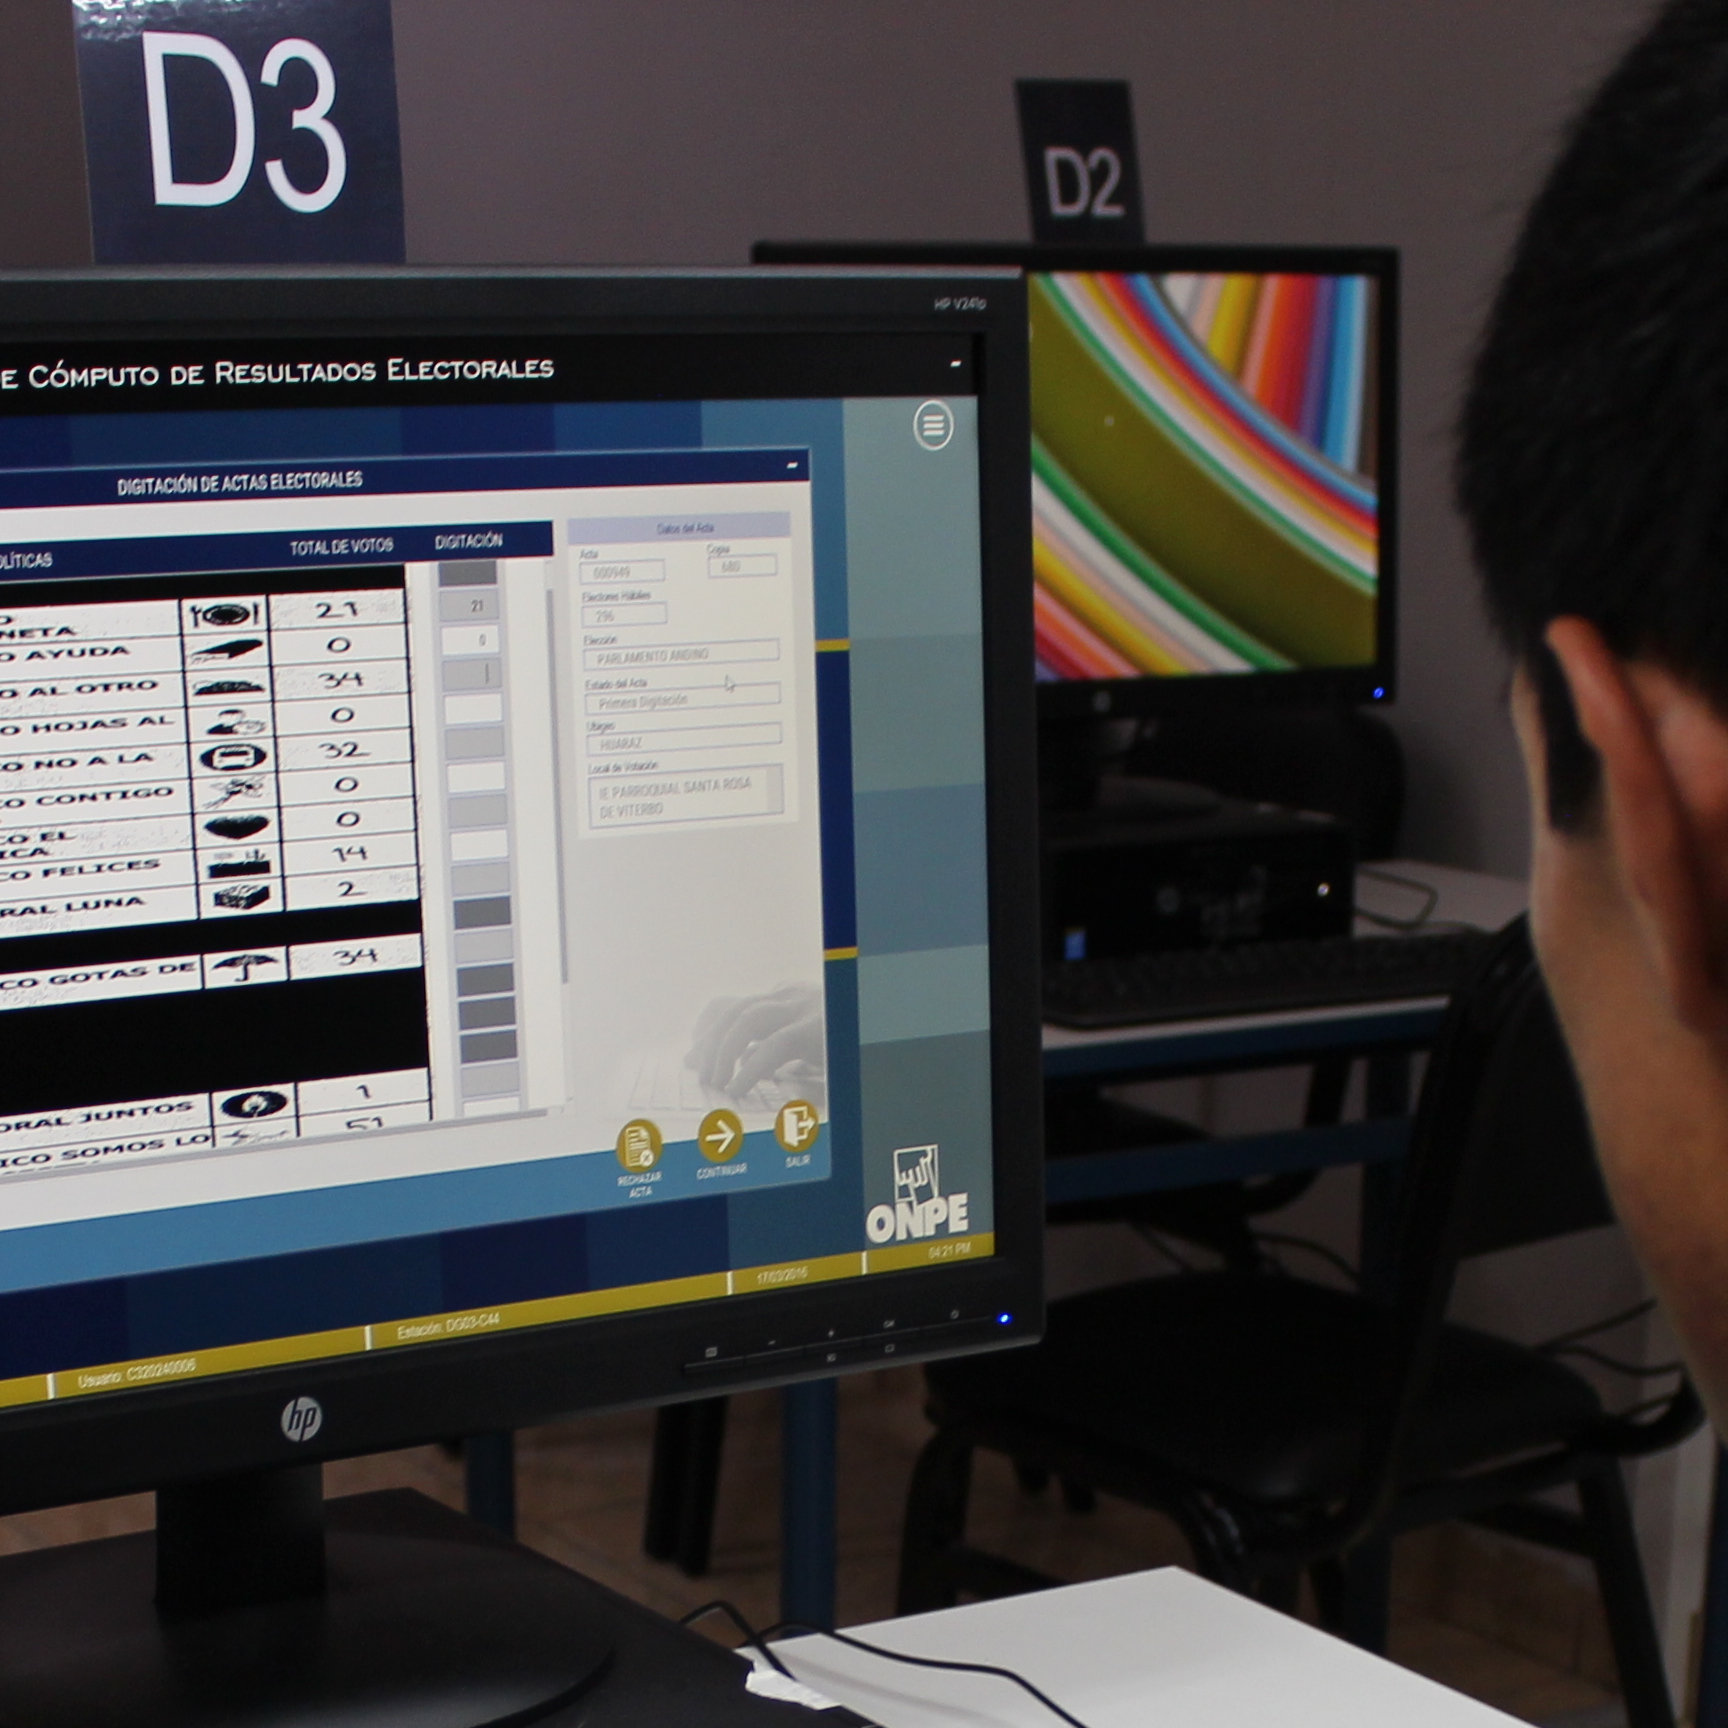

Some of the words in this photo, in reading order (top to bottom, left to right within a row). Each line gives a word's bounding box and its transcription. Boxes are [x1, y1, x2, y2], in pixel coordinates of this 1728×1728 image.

[141, 31, 348, 214] D3
[1043, 145, 1125, 221] D2
[117, 472, 199, 497] DIGITACIÓN
[200, 475, 221, 493] DE
[221, 474, 269, 493] ACTAS
[270, 469, 364, 491] ELECTORALES
[290, 540, 331, 556] TOTAL
[332, 539, 351, 554] DE
[352, 537, 395, 553] VOTOS
[434, 530, 504, 550] DIGITACIÓN
[315, 600, 358, 619] 21
[25, 645, 130, 661] AYUDA
[325, 636, 352, 654] 0
[28, 685, 65, 697] AL
[75, 679, 158, 695] OTRO
[317, 670, 364, 690] 34
[31, 717, 128, 734] HOJAS
[137, 714, 173, 726] AL
[329, 706, 355, 724] 0
[318, 739, 370, 760] 32
[33, 757, 78, 770] NO
[87, 755, 107, 766] A
[117, 752, 153, 764] LA
[333, 775, 360, 794] 0
[35, 786, 174, 807] CONTIGO
[335, 810, 361, 829] 0
[39, 830, 75, 842] EL
[332, 844, 368, 863] 14
[42, 858, 160, 879] FELICES
[337, 878, 366, 898] 2
[65, 895, 144, 912] LUNA
[333, 946, 378, 967] 34
[48, 966, 148, 986] GOTAS
[158, 961, 195, 975] DE
[79, 1099, 193, 1124] JUNTOS
[61, 1138, 165, 1161] SOMOS
[175, 1133, 210, 1147] LO
[785, 1154, 811, 1169] SALIR
[617, 1170, 663, 1187] RECHAZAR
[696, 1162, 749, 1181] CONTINUAR
[628, 1185, 653, 1199] ACTA
[865, 1192, 970, 1244] ONPE
[954, 1240, 972, 1256] PM
[282, 1395, 323, 1442] hp
